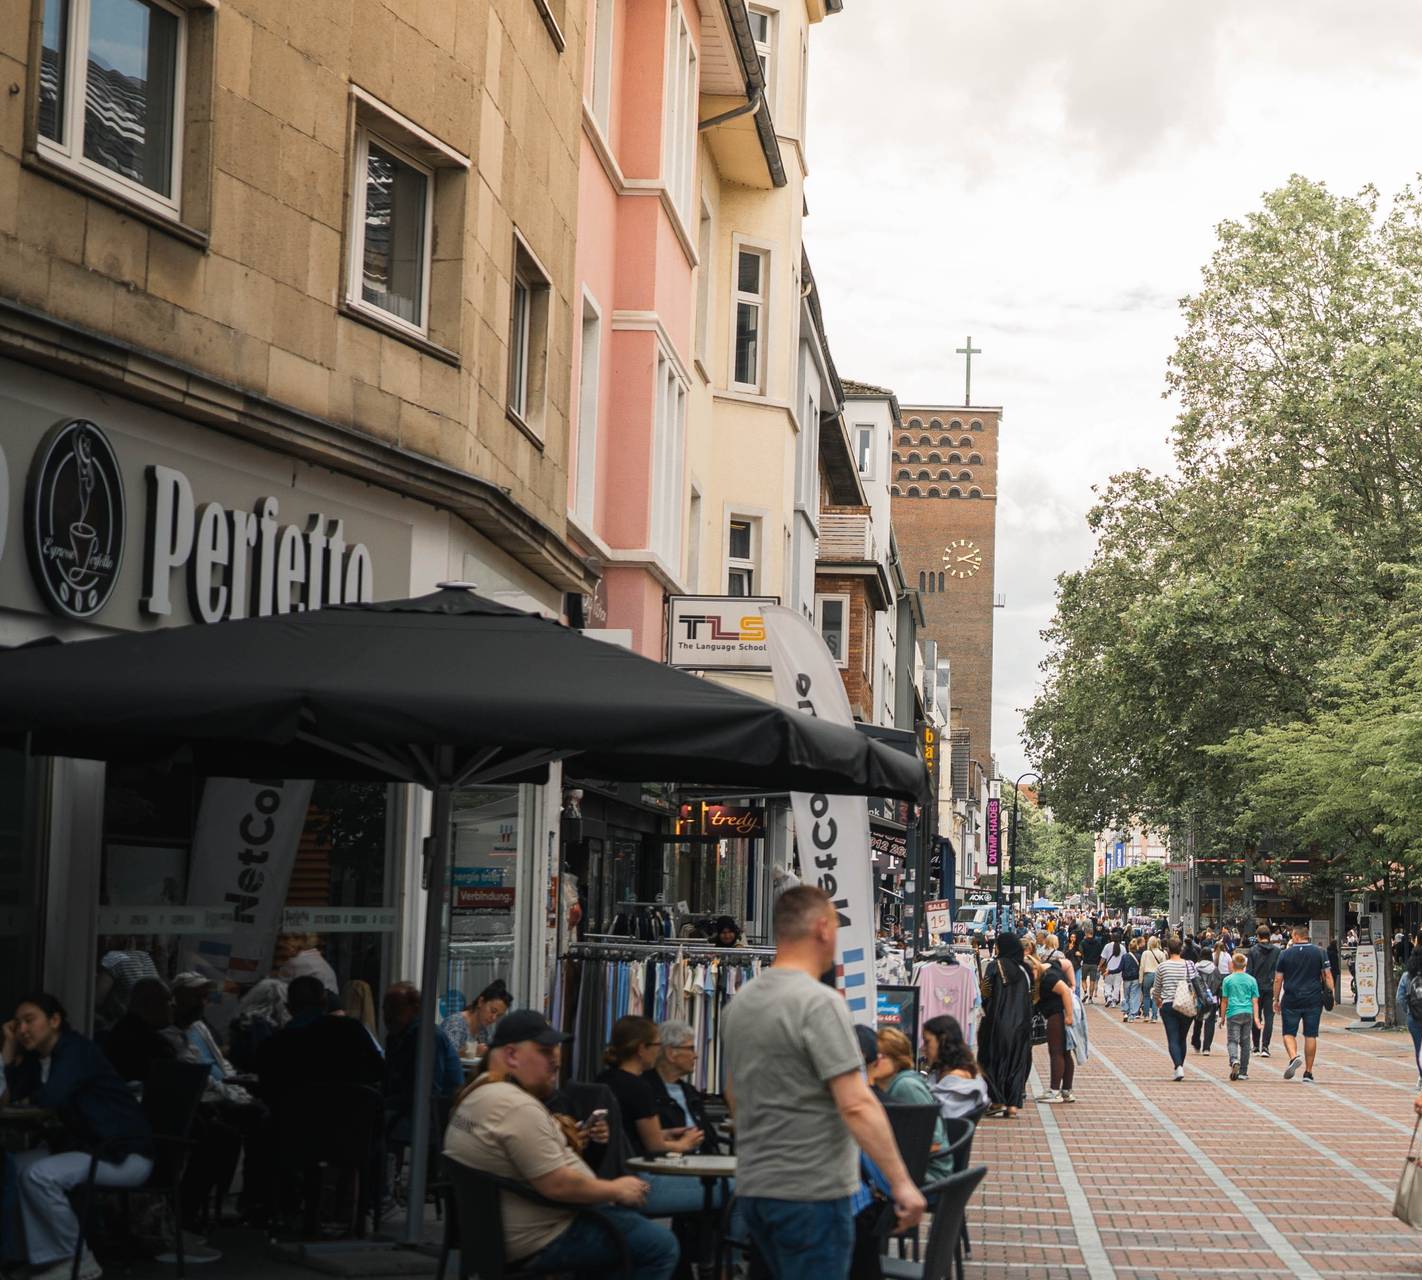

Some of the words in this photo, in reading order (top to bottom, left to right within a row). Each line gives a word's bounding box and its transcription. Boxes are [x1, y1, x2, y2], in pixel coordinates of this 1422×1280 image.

[142, 464, 374, 623] Perfetto
[679, 615, 767, 640] TLS
[678, 642, 693, 650] The
[696, 643, 736, 651] Language
[711, 811, 760, 834] tredy
[927, 902, 947, 911] SALE
[930, 914, 946, 929] 15
